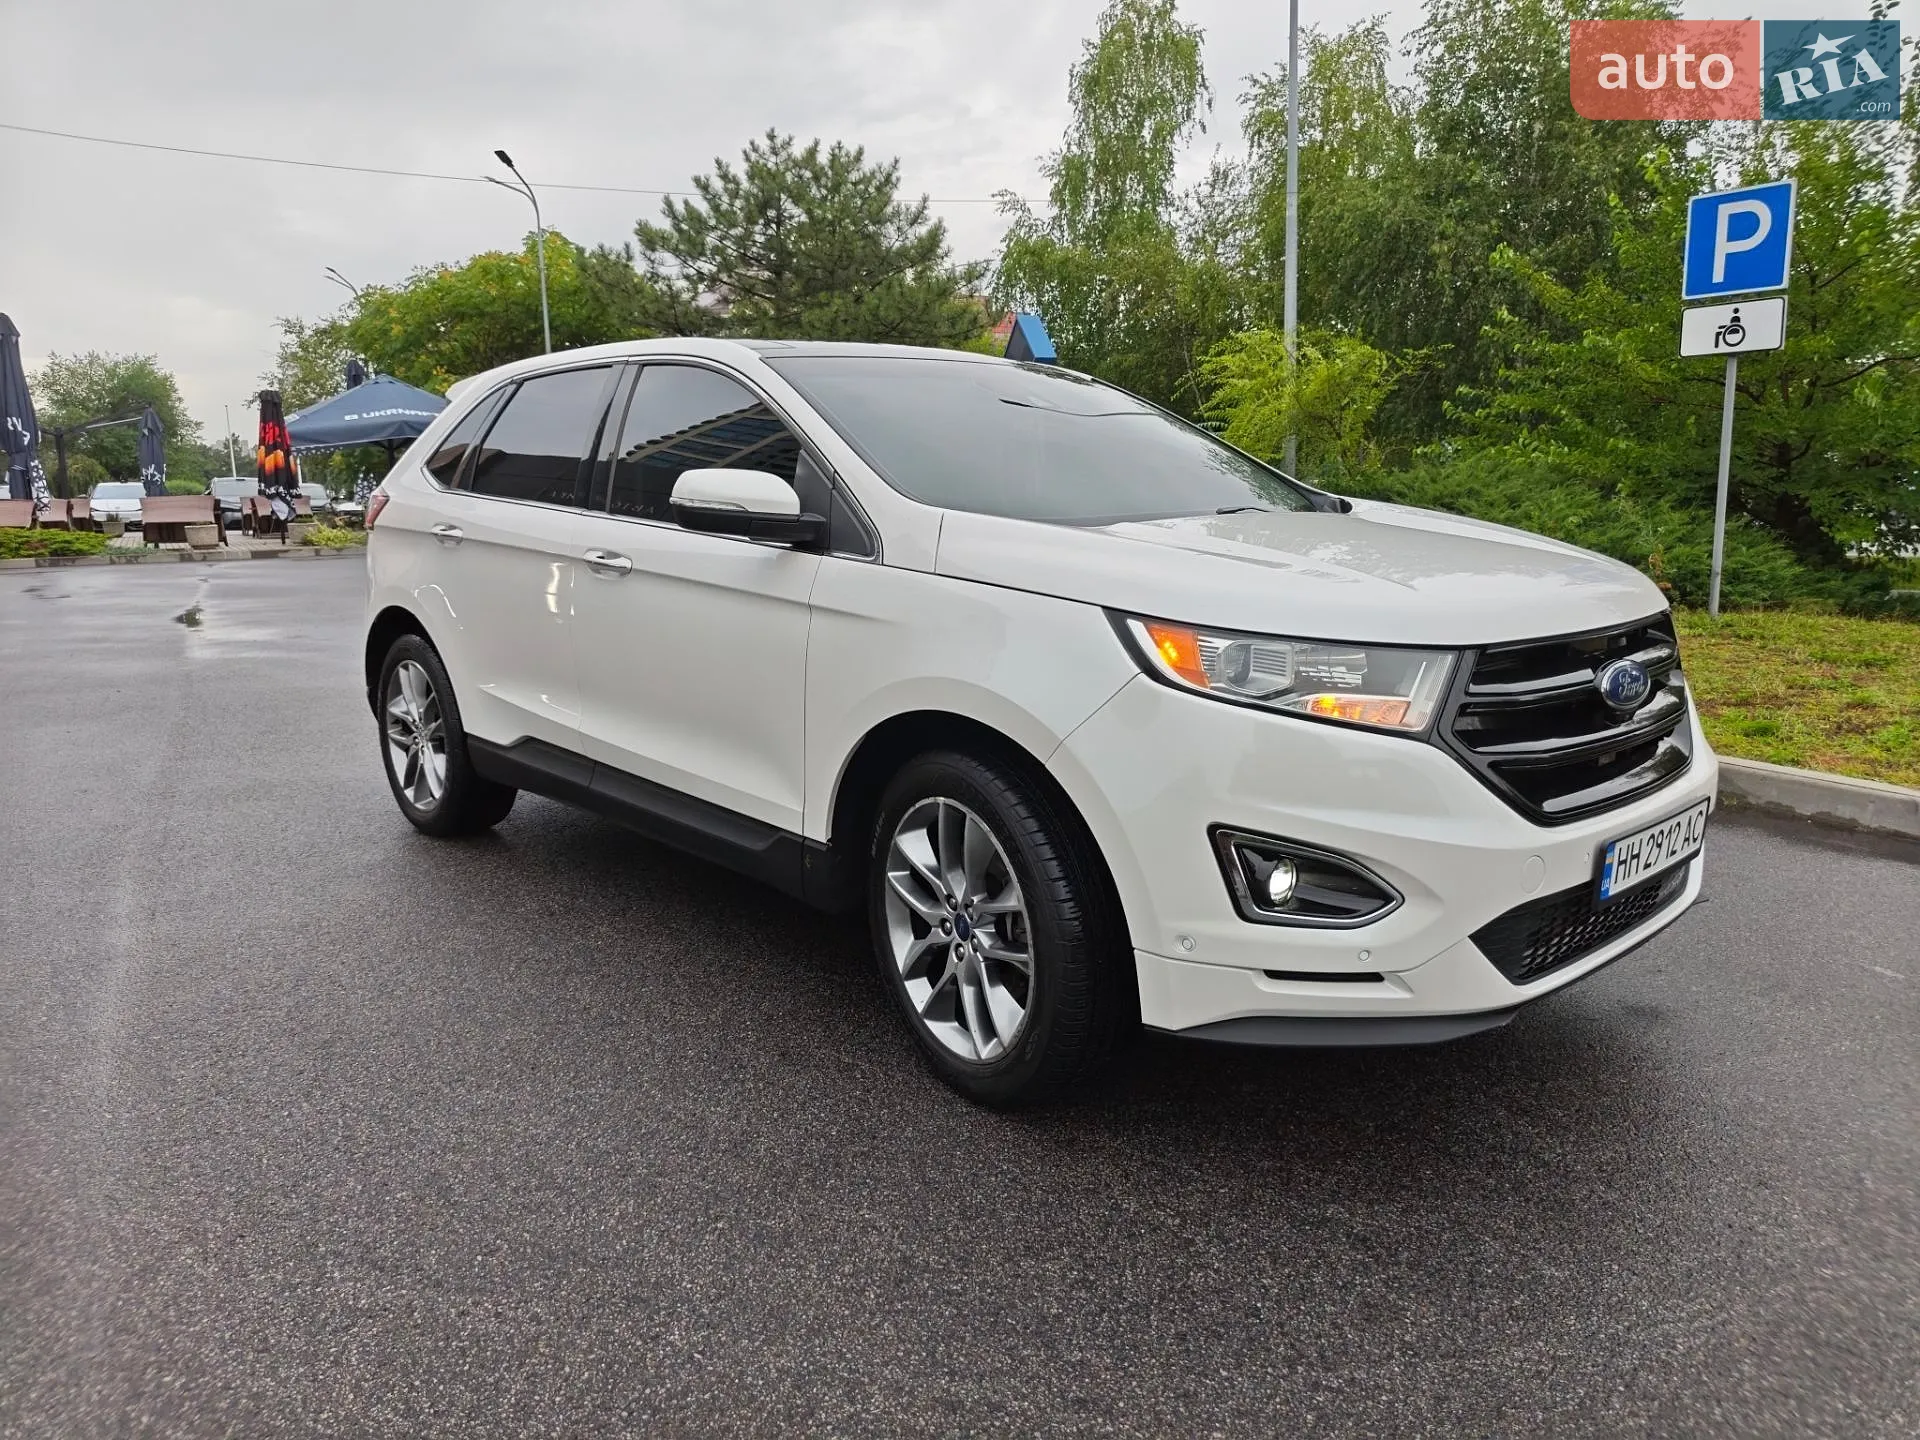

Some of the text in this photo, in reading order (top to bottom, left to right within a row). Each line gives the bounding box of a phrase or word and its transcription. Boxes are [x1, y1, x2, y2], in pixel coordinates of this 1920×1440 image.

[1712, 199, 1772, 284] P
[1618, 671, 1645, 697] Ford
[1614, 810, 1704, 884] HH 2912 AC
